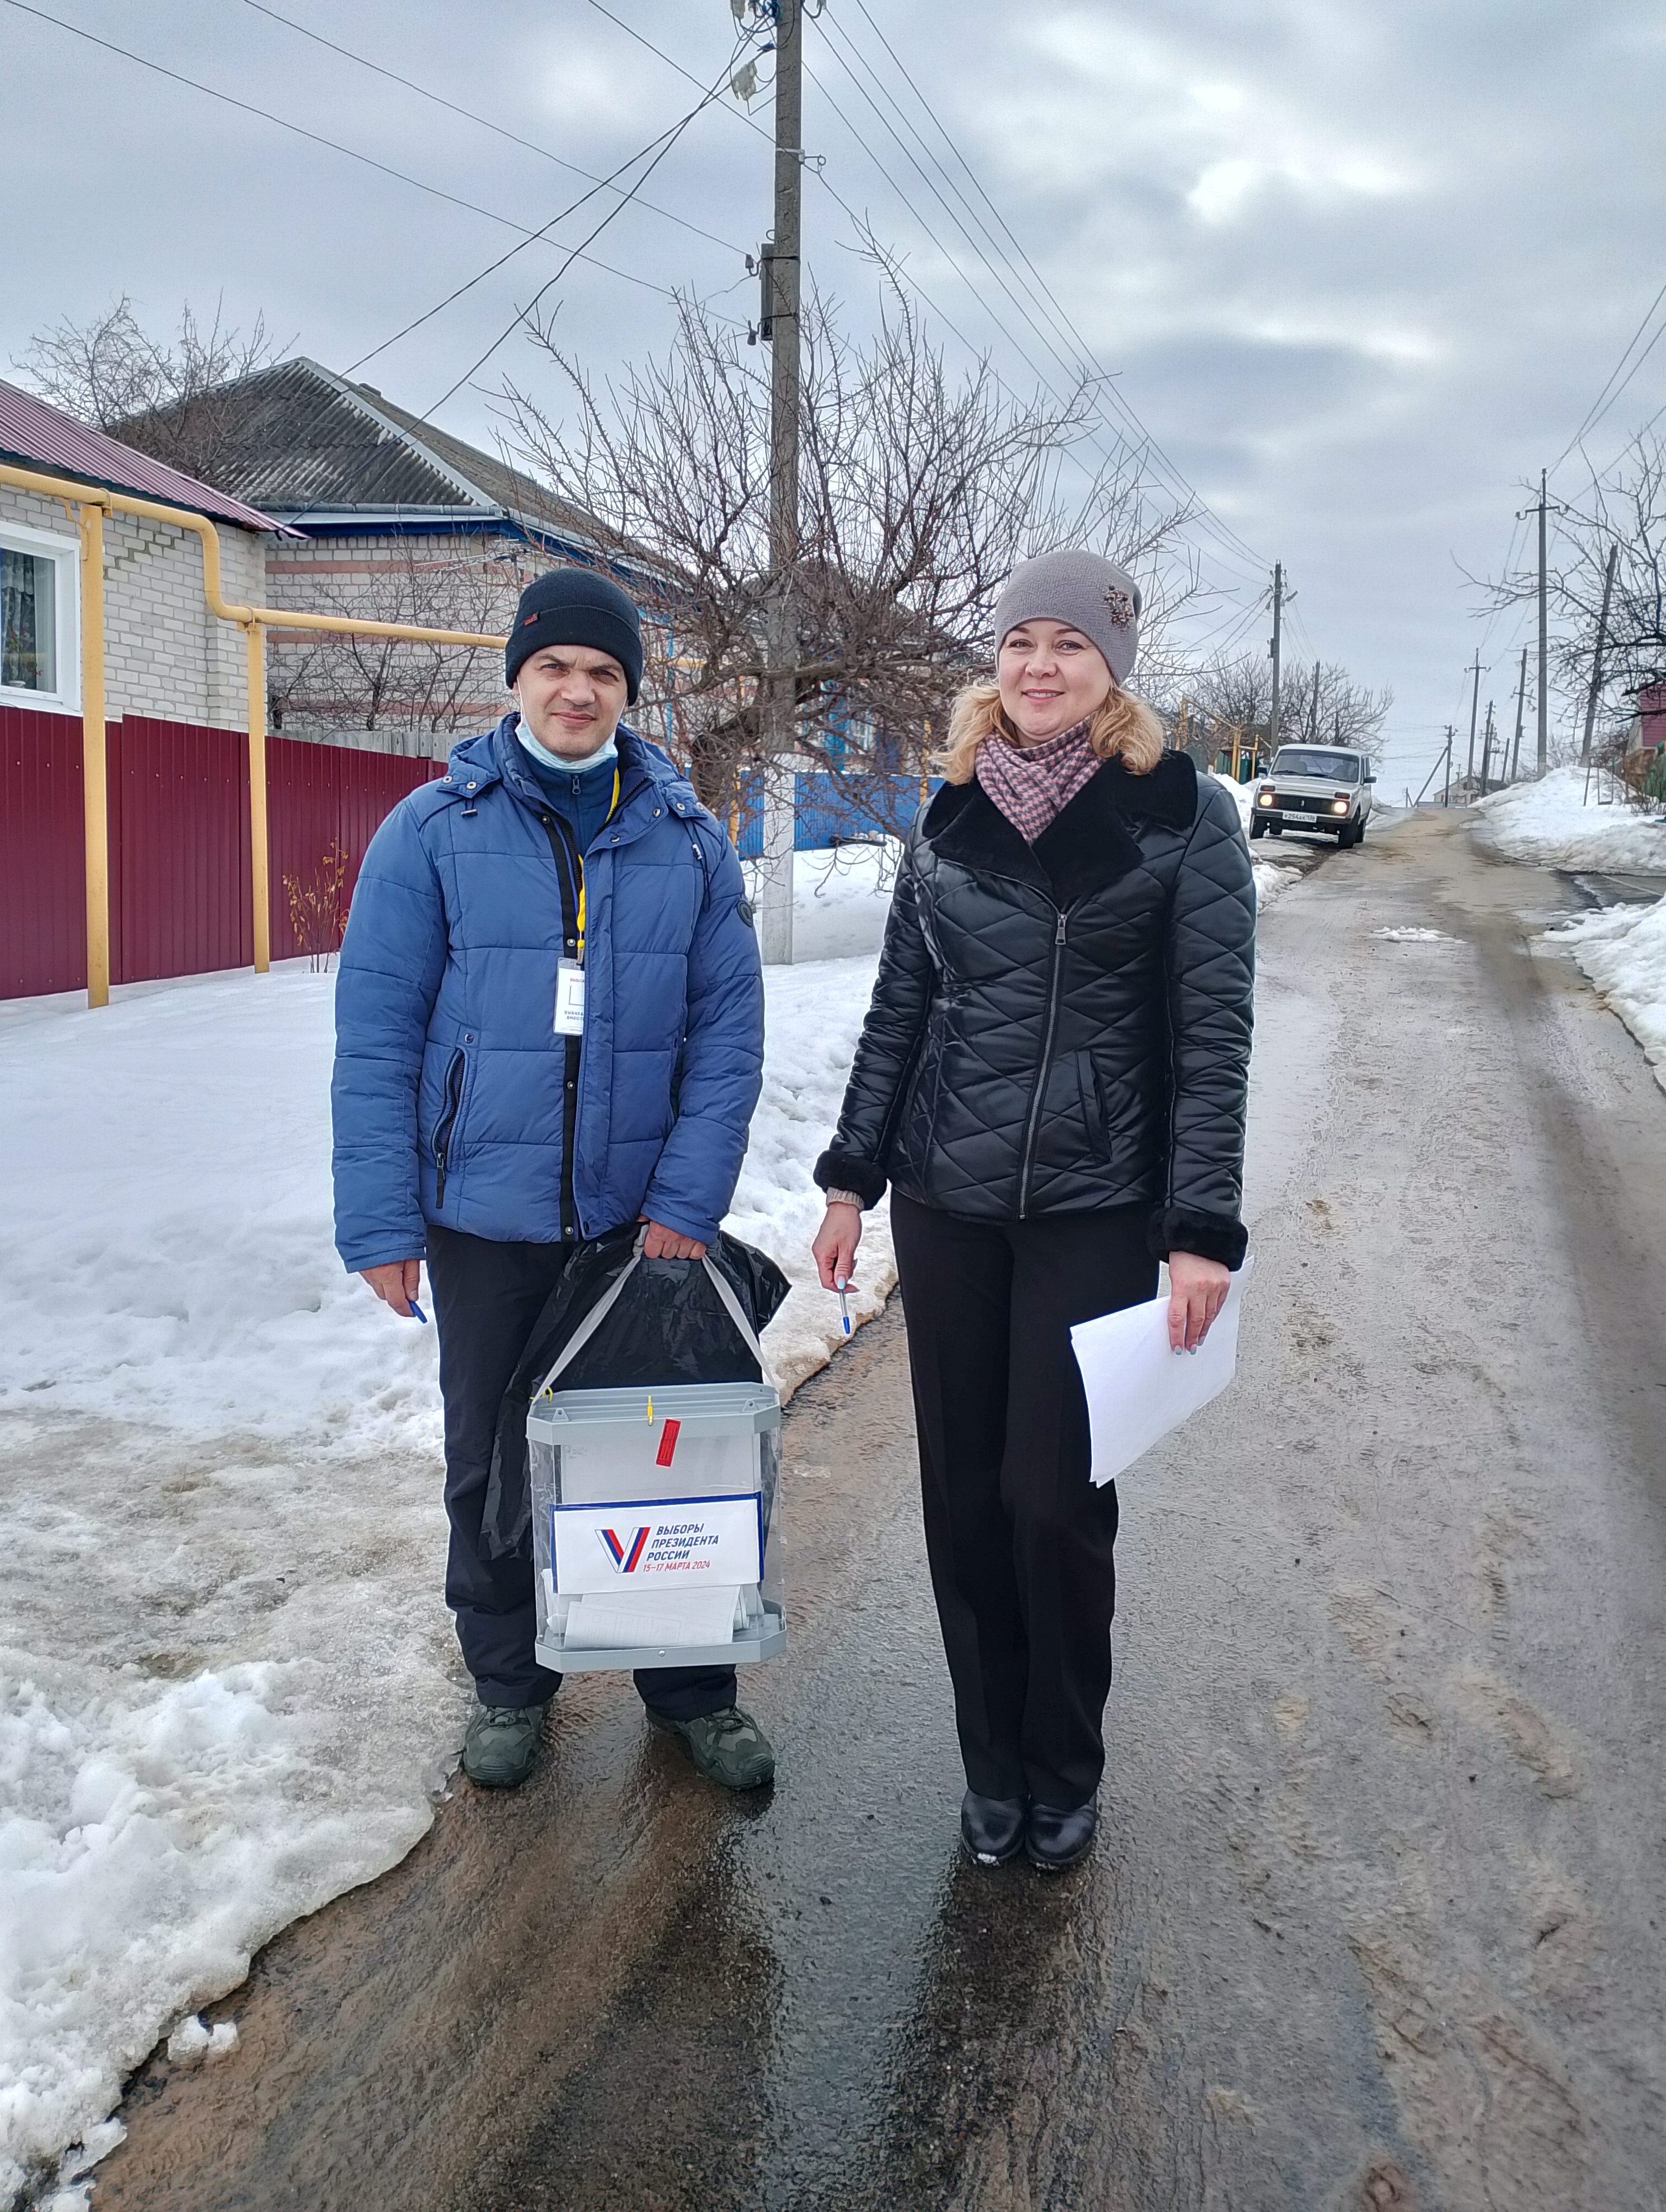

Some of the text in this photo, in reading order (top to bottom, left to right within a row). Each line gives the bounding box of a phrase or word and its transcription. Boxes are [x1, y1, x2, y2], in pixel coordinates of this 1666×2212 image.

[656, 1523, 704, 1535] ВЫБОРЫ
[651, 1535, 719, 1549] ПРЕЗИДЕНТА
[646, 1549, 690, 1561] РОССИИ
[664, 1561, 691, 1572] МАРТА
[691, 1560, 710, 1570] 2024
